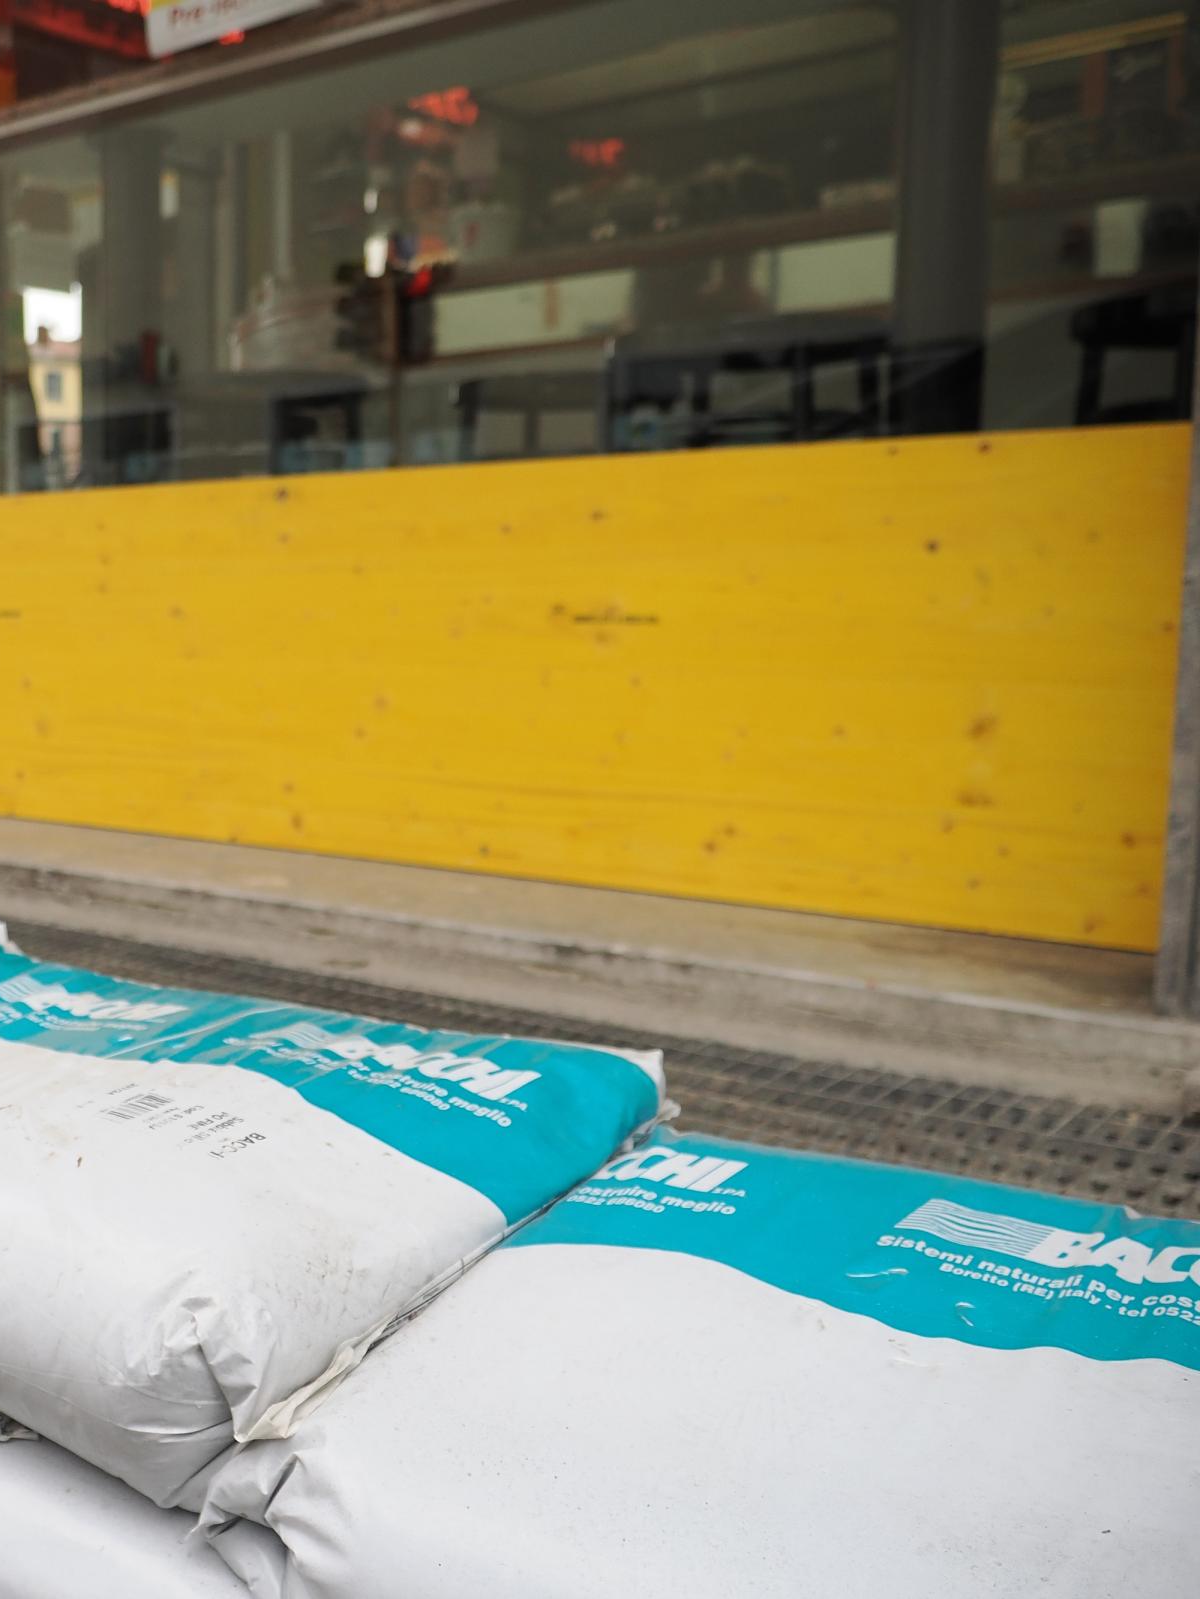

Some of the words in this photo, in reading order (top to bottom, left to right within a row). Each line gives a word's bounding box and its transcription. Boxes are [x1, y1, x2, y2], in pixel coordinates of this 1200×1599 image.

[327, 1035, 542, 1101] BACCHI
[449, 1096, 512, 1128] meglio
[577, 1185, 658, 1201] ostruire
[660, 1195, 737, 1216] meglio
[876, 1234, 970, 1267] Sistemi
[977, 1260, 1083, 1293] naturali
[1088, 1278, 1136, 1306] per
[938, 1261, 1009, 1288] Boretto
[1012, 1279, 1055, 1301] (RE)
[1117, 1306, 1149, 1318] tel
